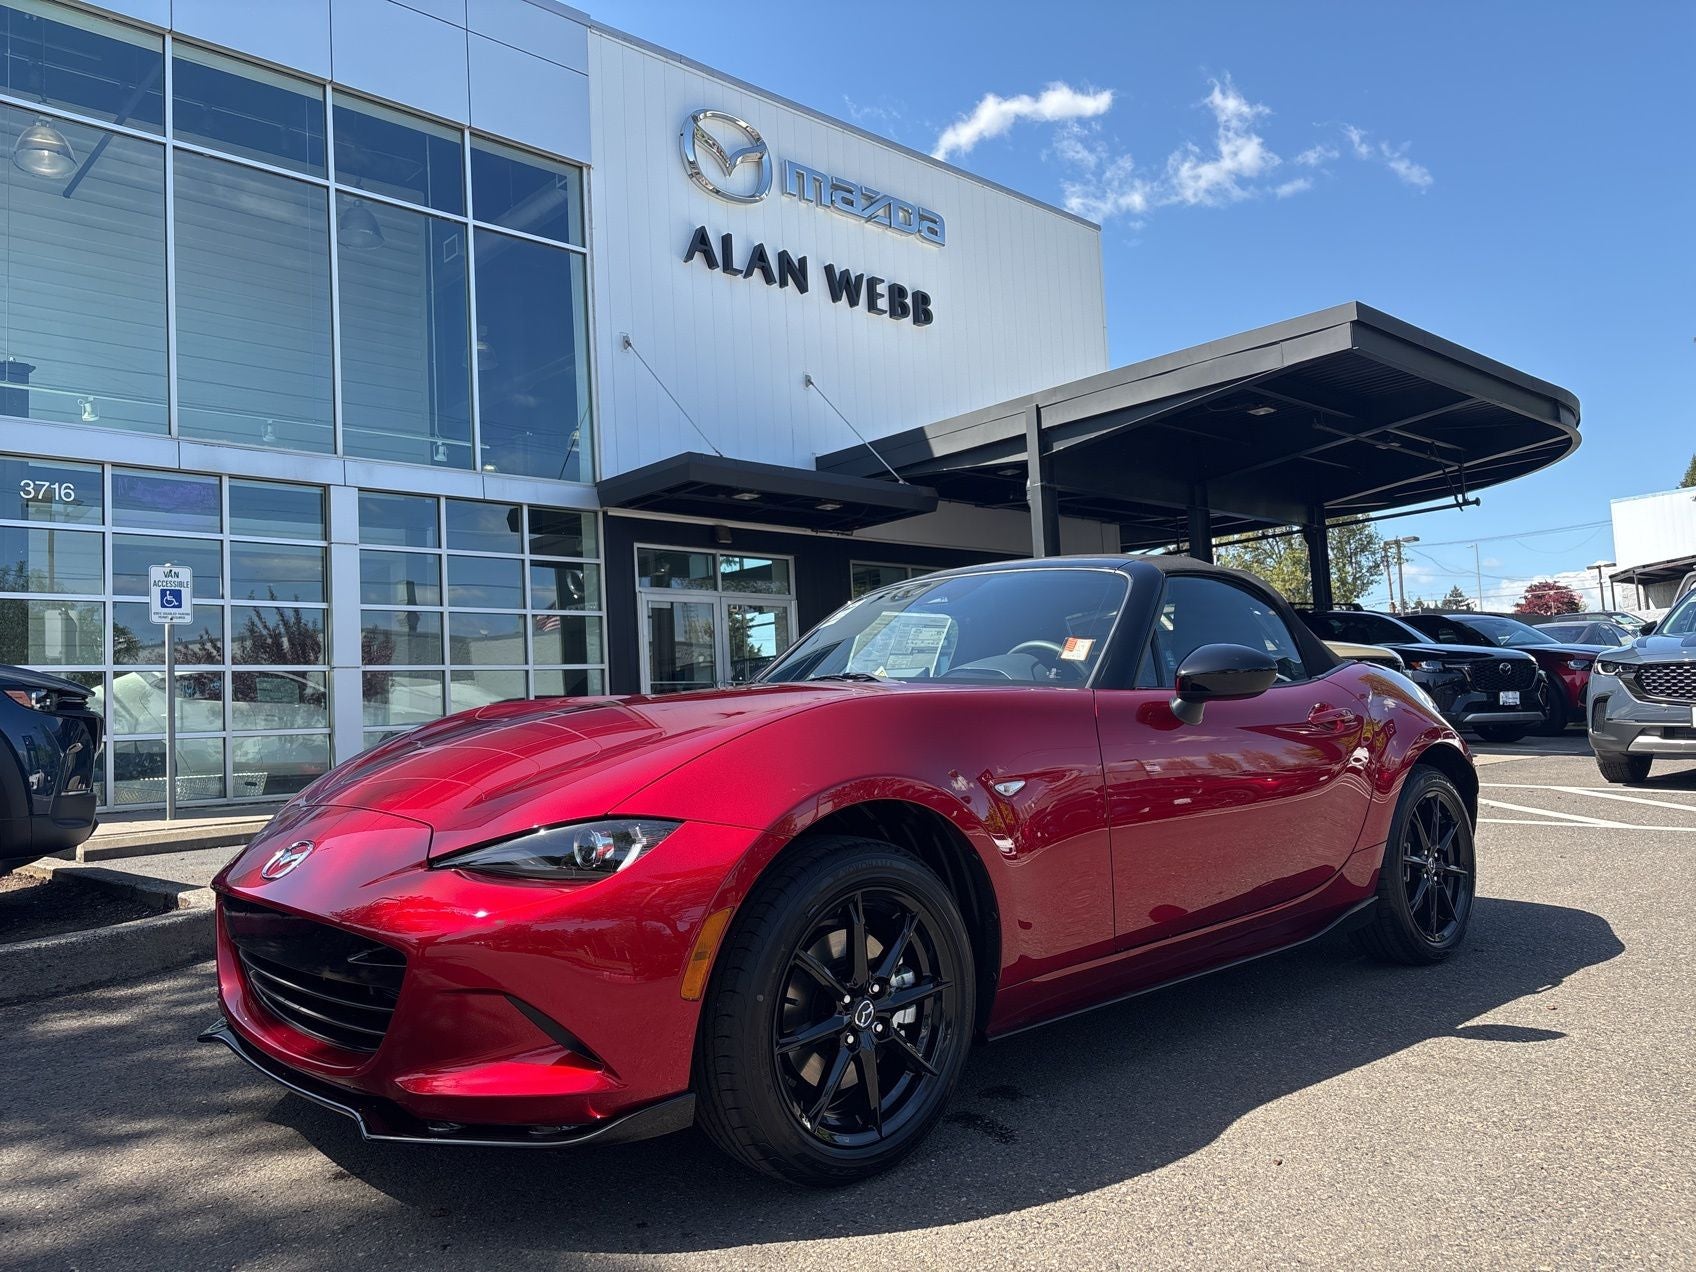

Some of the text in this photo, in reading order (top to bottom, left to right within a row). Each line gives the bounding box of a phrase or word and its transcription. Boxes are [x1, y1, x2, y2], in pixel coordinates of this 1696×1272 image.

[683, 225, 934, 327] ALAN WEBB
[19, 479, 75, 502] 3716
[163, 570, 180, 579] VAN
[152, 579, 190, 589] ACCESSIBLE
